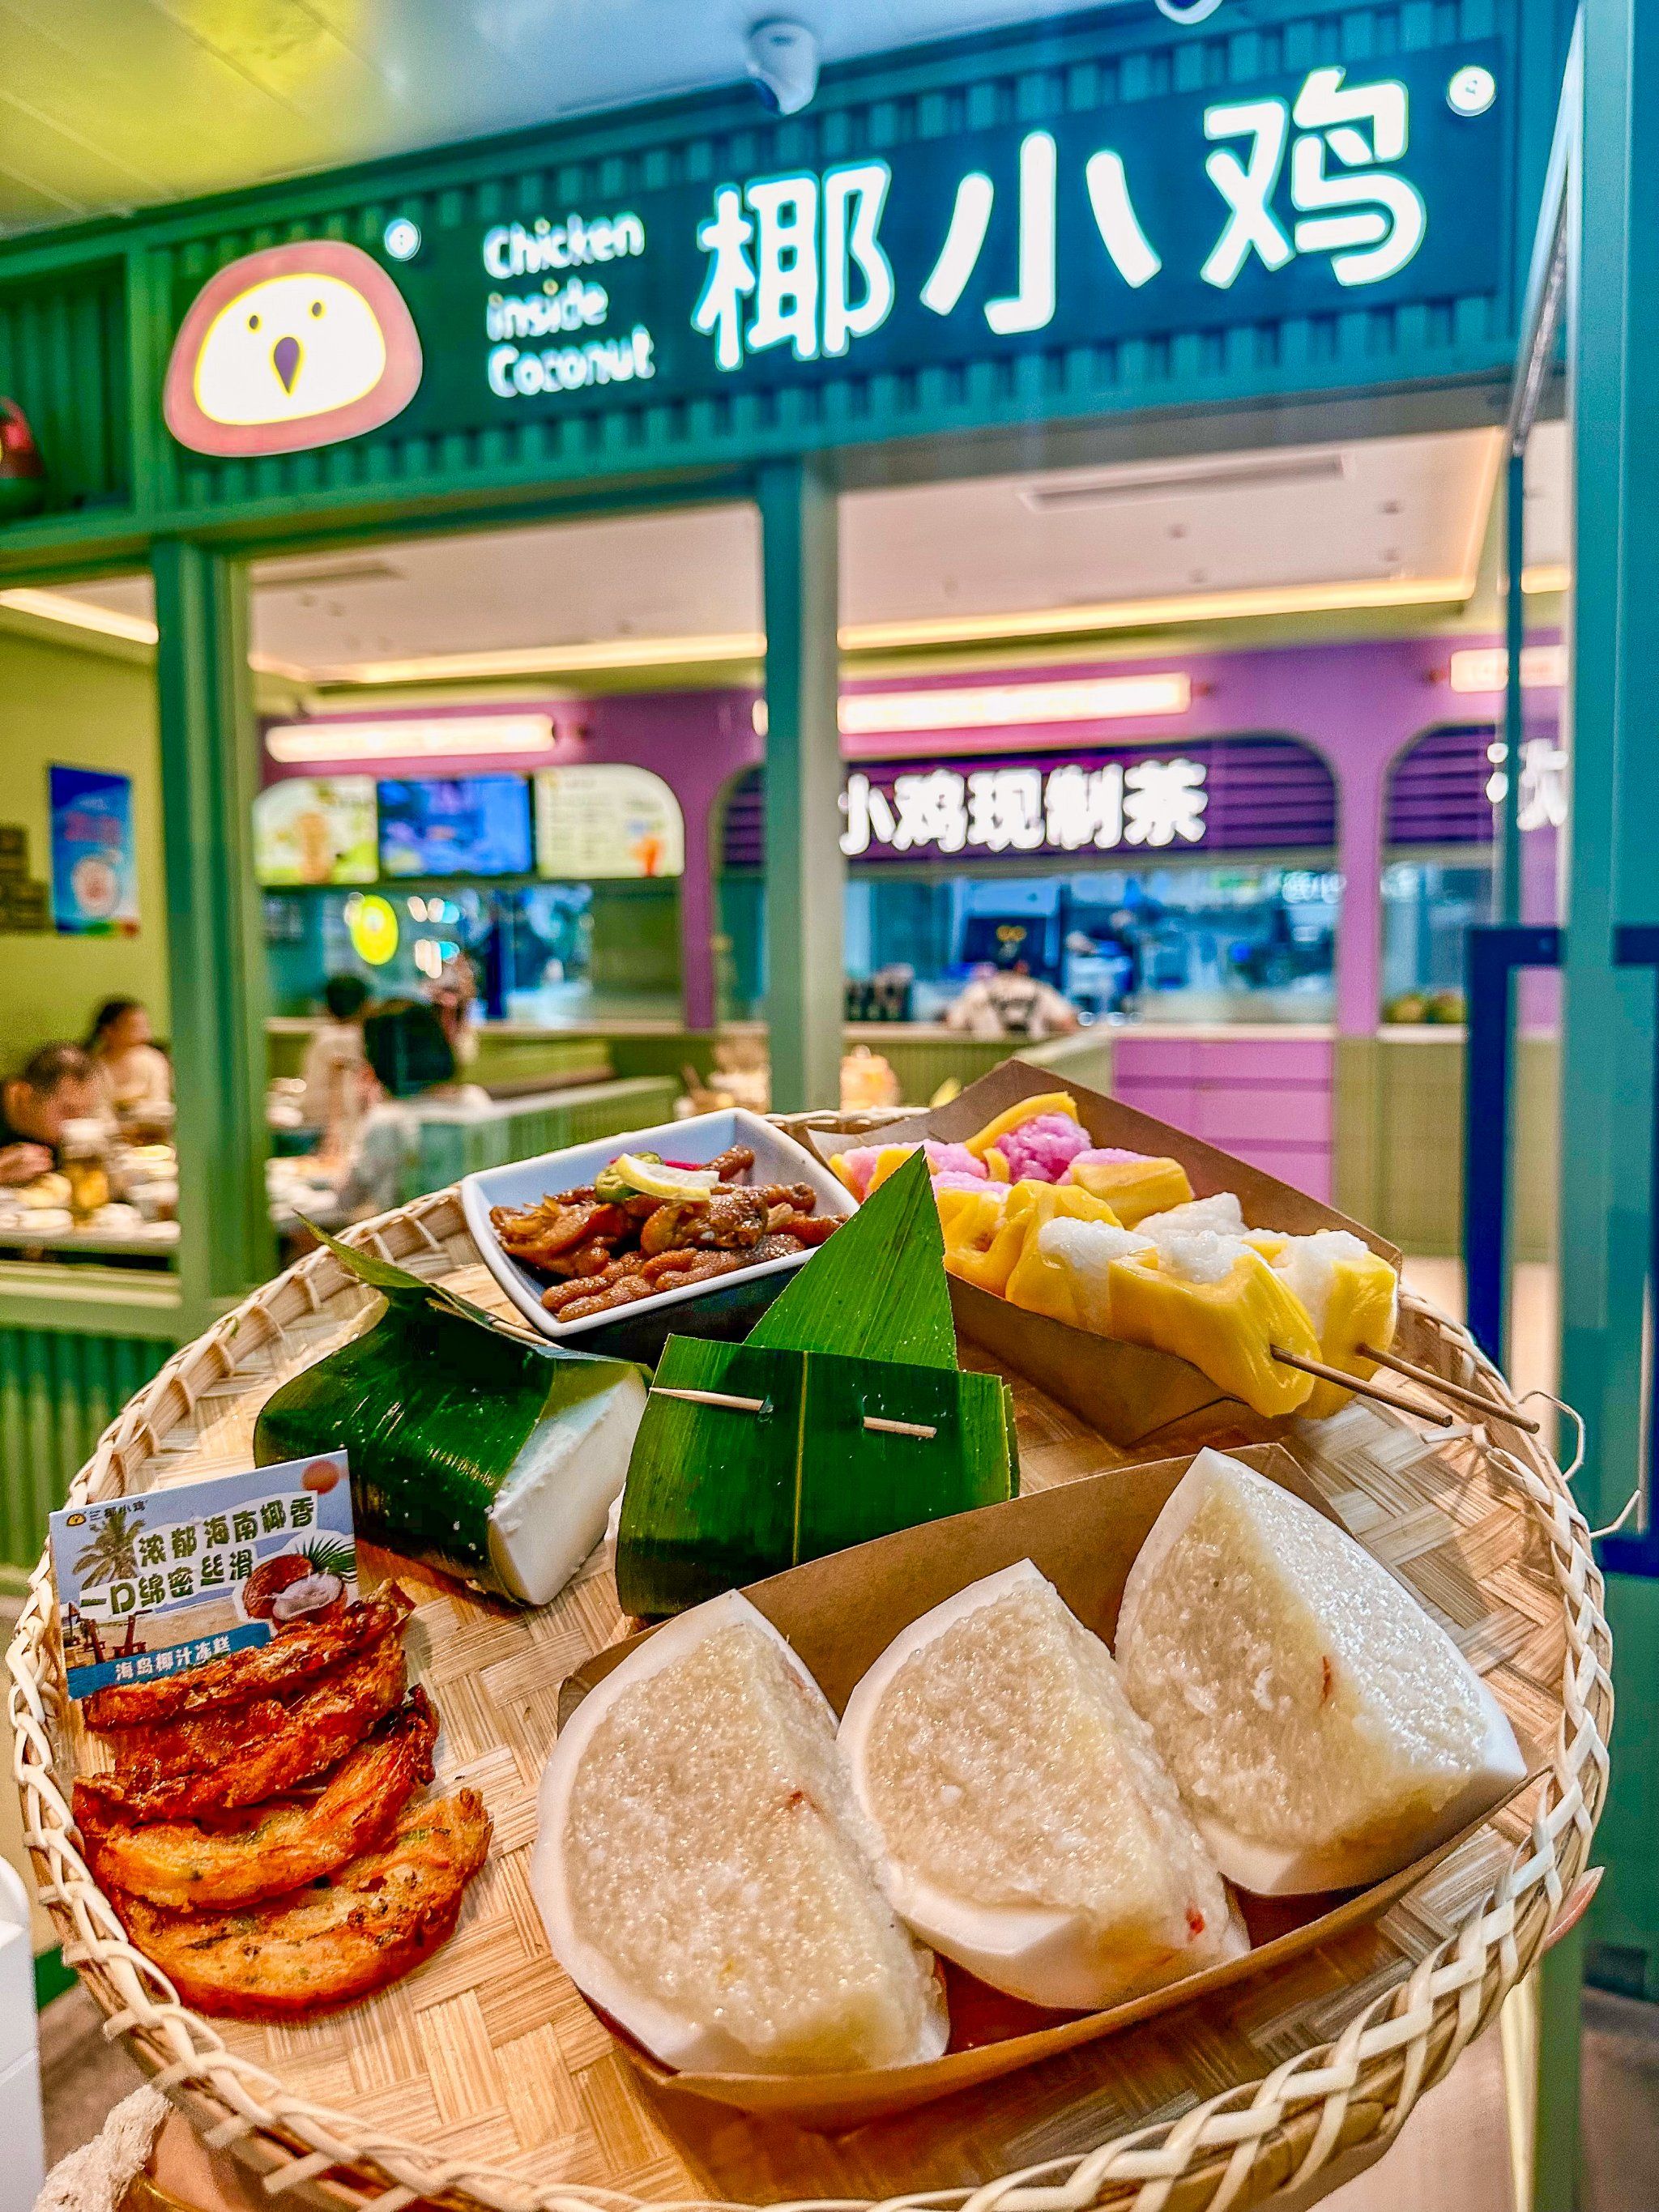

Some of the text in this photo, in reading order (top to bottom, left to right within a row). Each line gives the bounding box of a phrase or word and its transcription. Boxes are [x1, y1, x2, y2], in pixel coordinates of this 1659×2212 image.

[484, 211, 646, 279] Chicken
[690, 66, 1427, 371] 椰小鸡
[486, 275, 608, 342] inside
[488, 322, 656, 399] Coconut
[137, 1495, 315, 1567] 浓郁海南椰香
[80, 1549, 254, 1615] 一口绵密丝滑
